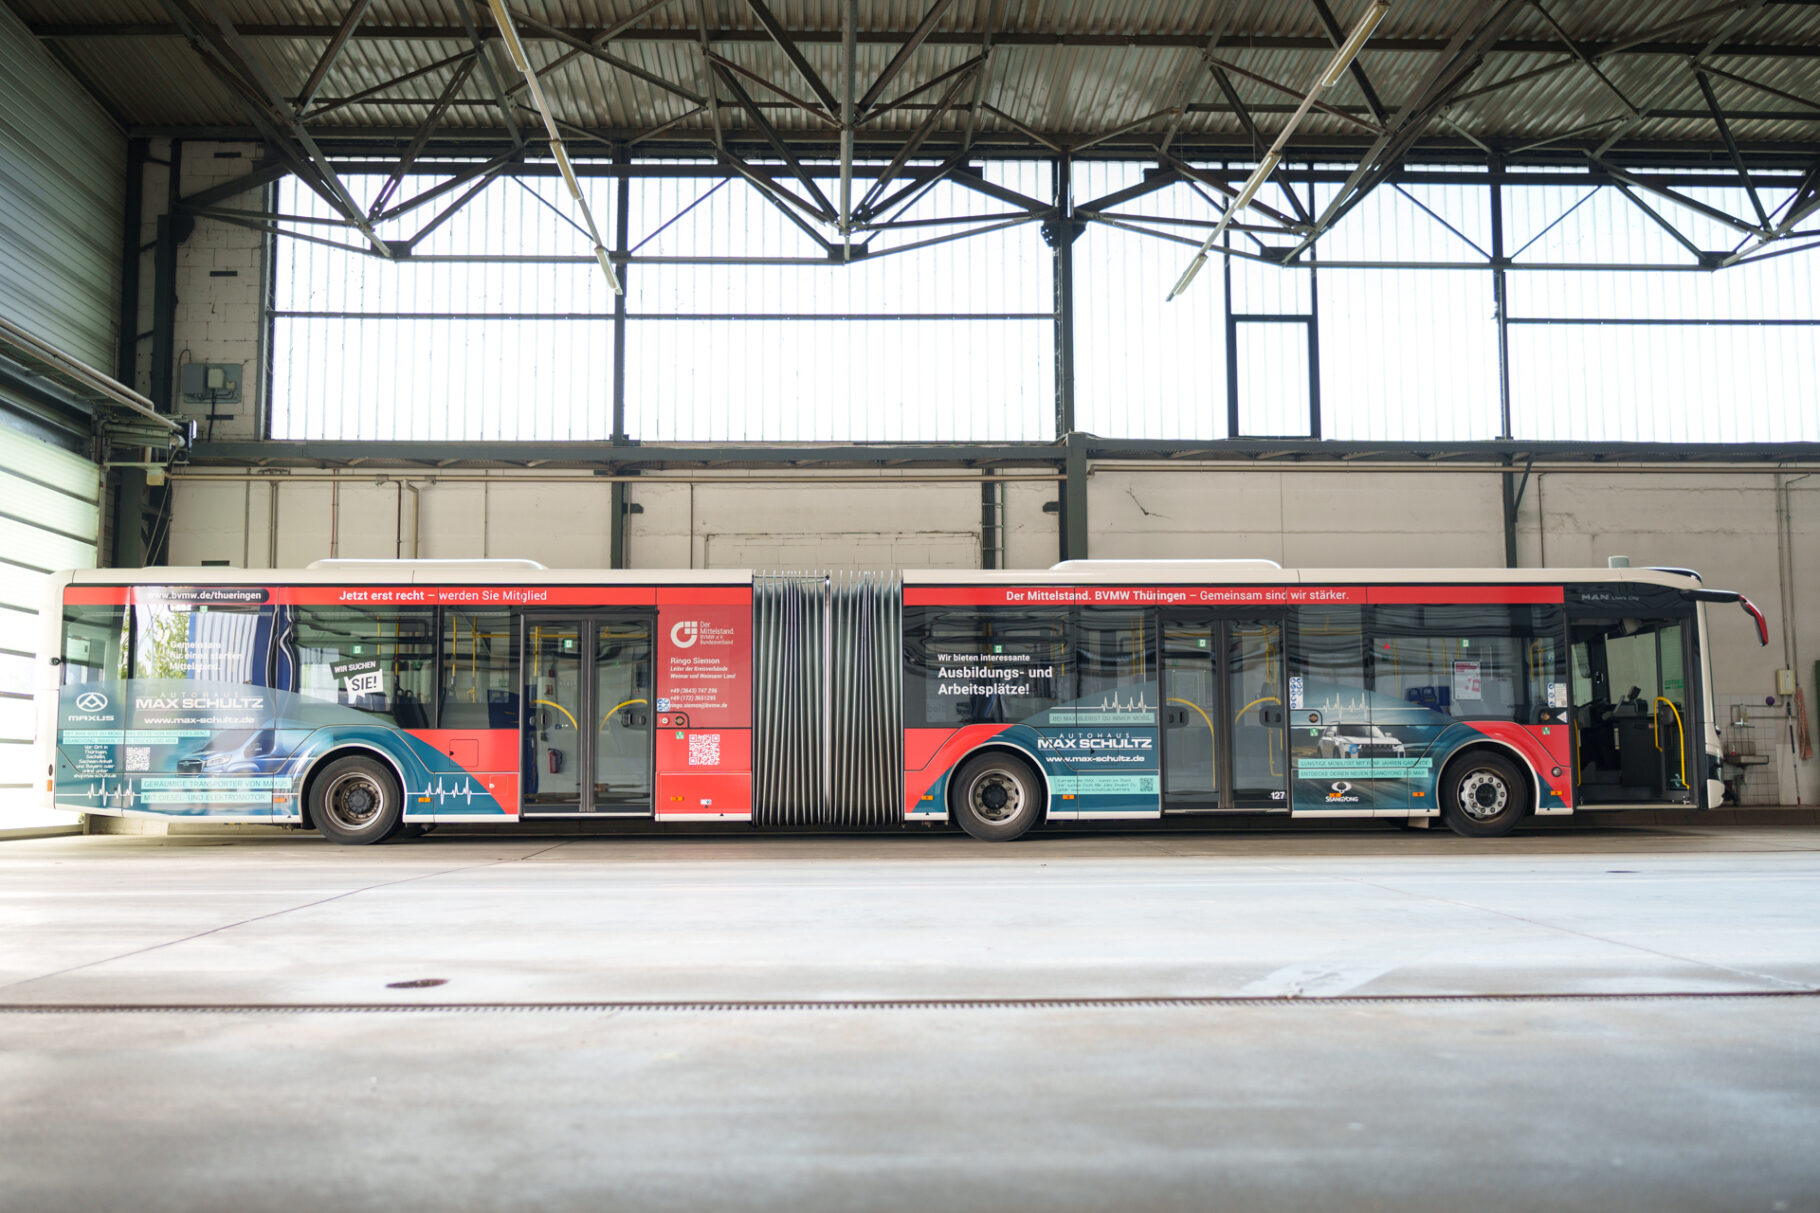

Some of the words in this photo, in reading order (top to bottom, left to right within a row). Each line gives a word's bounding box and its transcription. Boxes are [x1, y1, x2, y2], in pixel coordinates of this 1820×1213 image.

[339, 591, 368, 600] Jetzt
[371, 591, 393, 600] erst
[396, 591, 424, 600] recht
[438, 591, 479, 600] werden
[482, 591, 499, 600] Sie
[502, 590, 547, 602] Mitglied
[1006, 591, 1024, 600] Der
[1027, 591, 1092, 600] Mittelstand.
[1095, 591, 1130, 600] BVMW
[1133, 590, 1186, 602] Thüringen
[1200, 590, 1263, 600] Gemeinsam
[1265, 590, 1287, 600] sind
[1290, 590, 1307, 600] wir
[1309, 590, 1350, 600] stärker.
[670, 657, 691, 666] Ringo
[938, 654, 952, 662] Wir
[954, 654, 979, 662] bieten
[980, 654, 1031, 662] interessante
[334, 665, 348, 673] WIR
[348, 660, 376, 671] SUCHEN
[938, 666, 1025, 680] Ausbildungs-
[1028, 666, 1053, 678] und
[351, 676, 377, 691] SIE!
[938, 683, 1030, 697] Arbeitsplätze!
[135, 698, 180, 709] MAX
[182, 698, 264, 709] SCHULTZ
[144, 715, 255, 725] www.max-schultz.de
[1038, 739, 1077, 748] MAX
[1079, 739, 1152, 748] SCHULTZ
[1271, 791, 1285, 800] 127
